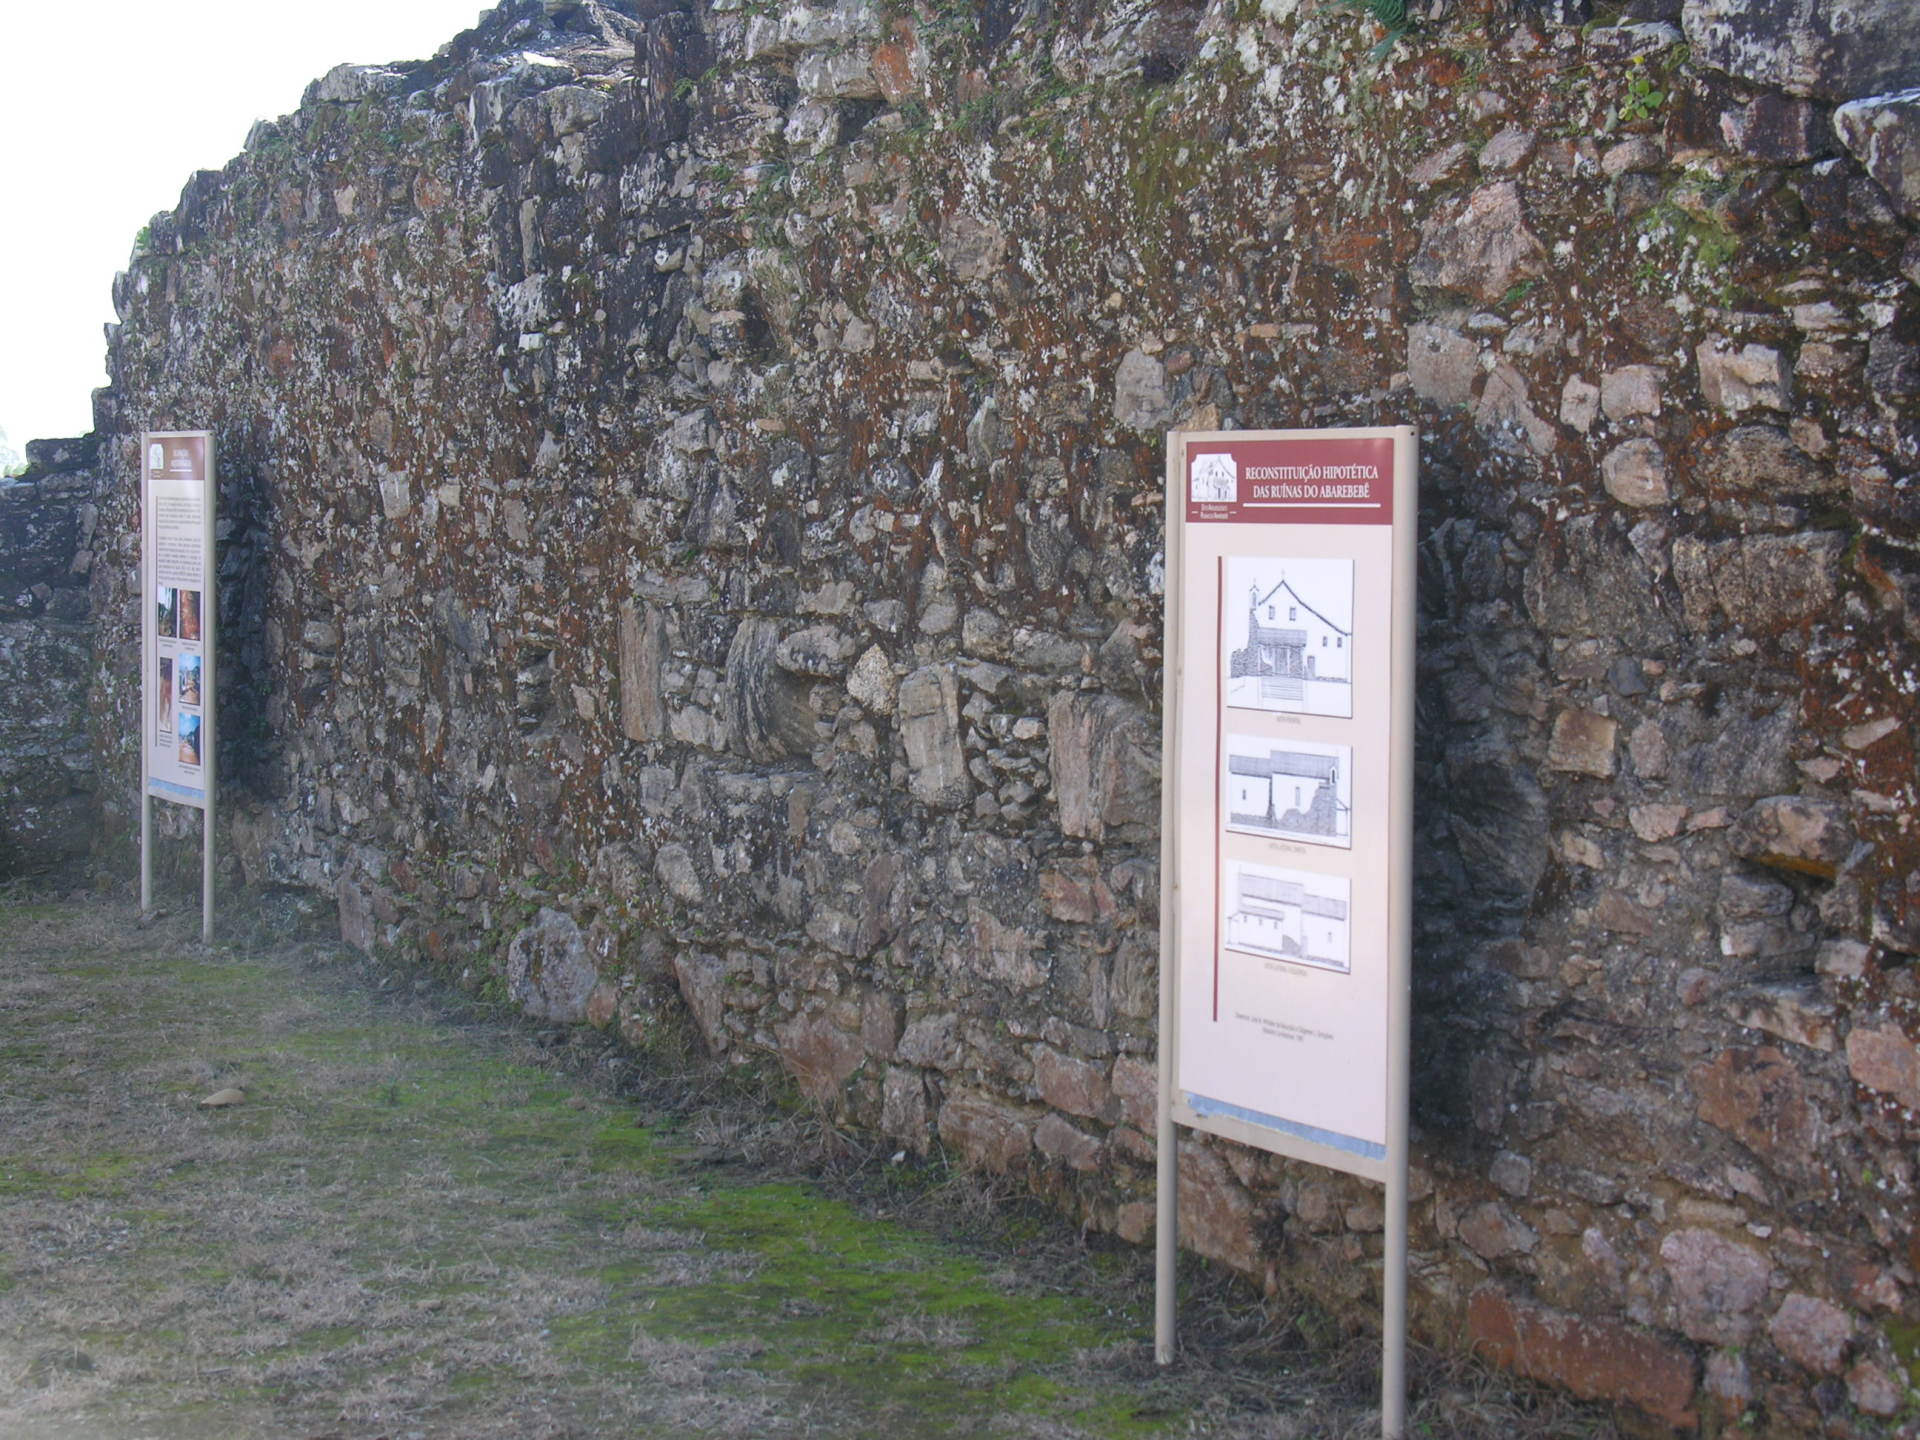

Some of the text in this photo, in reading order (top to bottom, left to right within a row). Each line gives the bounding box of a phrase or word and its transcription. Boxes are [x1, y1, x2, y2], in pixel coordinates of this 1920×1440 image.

[1245, 463, 1379, 482] RECONSTITUIÇÃO HIPOTÉTICA
[1253, 482, 1370, 498] DAS RUÍNAS DO ABAREBEBÊ
